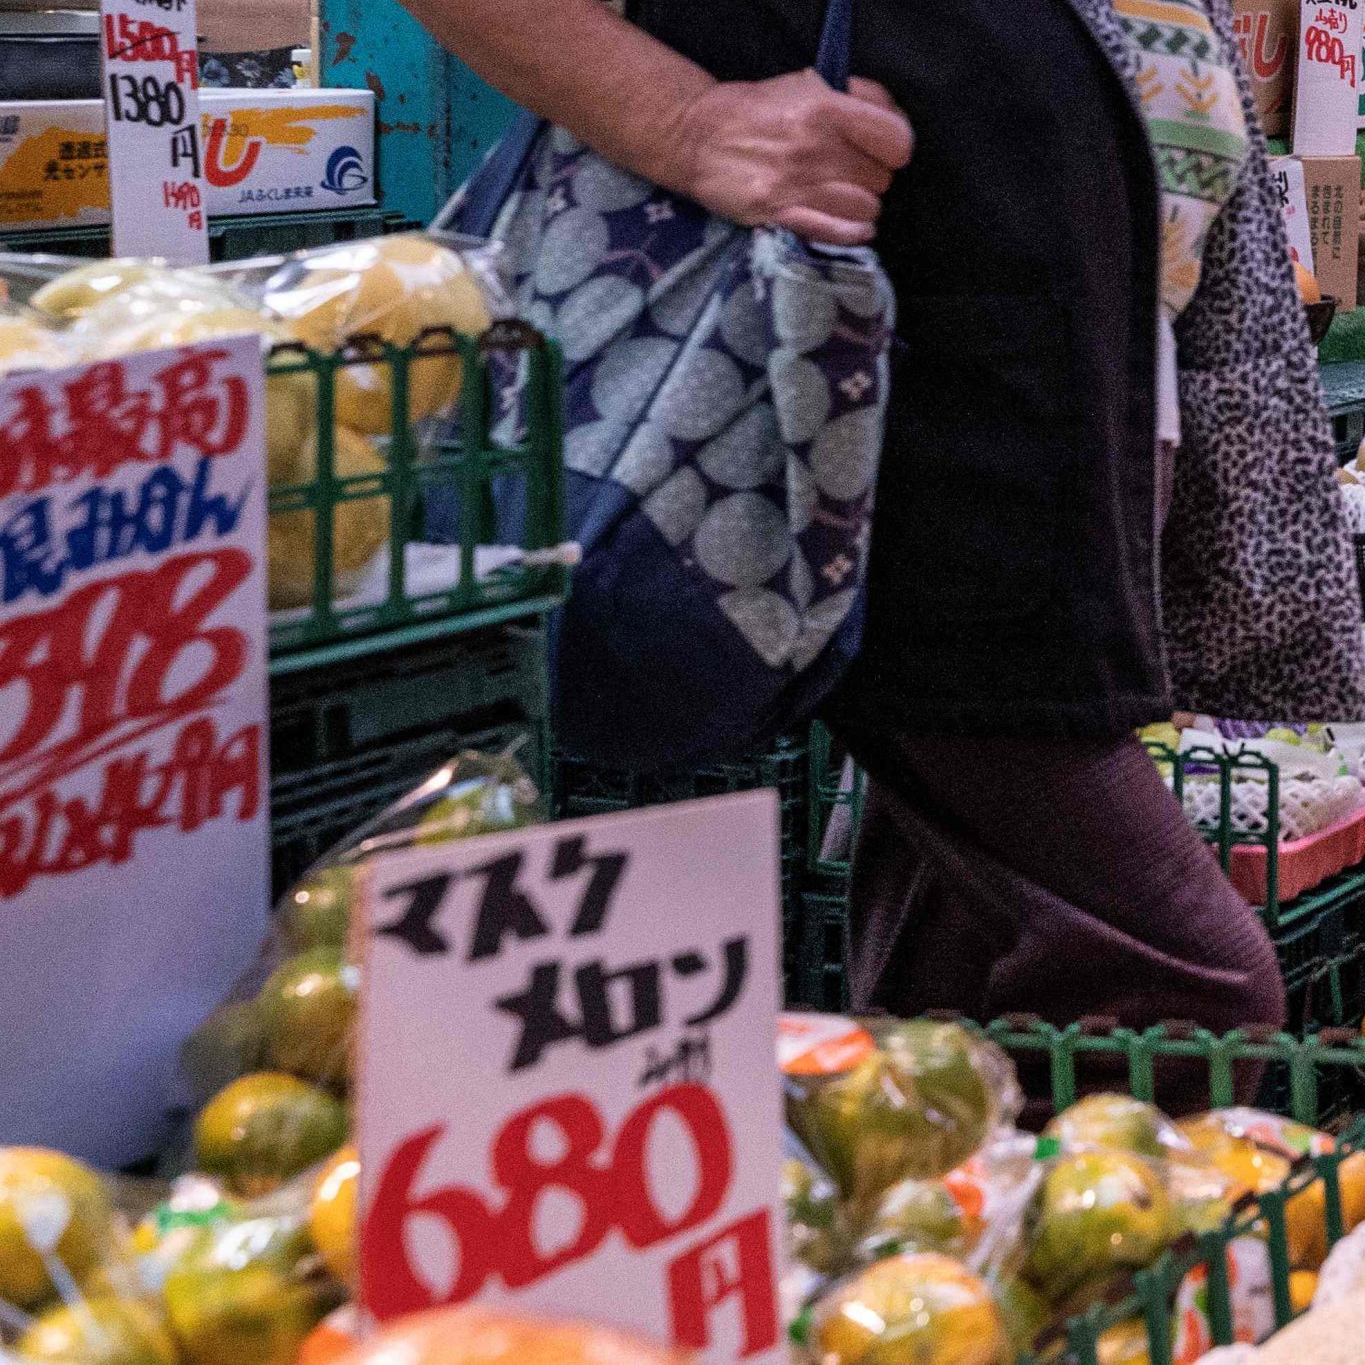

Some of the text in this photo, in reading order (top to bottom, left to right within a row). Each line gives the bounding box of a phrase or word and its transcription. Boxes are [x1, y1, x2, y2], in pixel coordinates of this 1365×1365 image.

[1305, 26, 1356, 89] 980円
[109, 73, 200, 178] 1380円
[375, 834, 633, 963] マスク
[492, 936, 750, 1075] メロン
[361, 1080, 781, 1361] 680円
